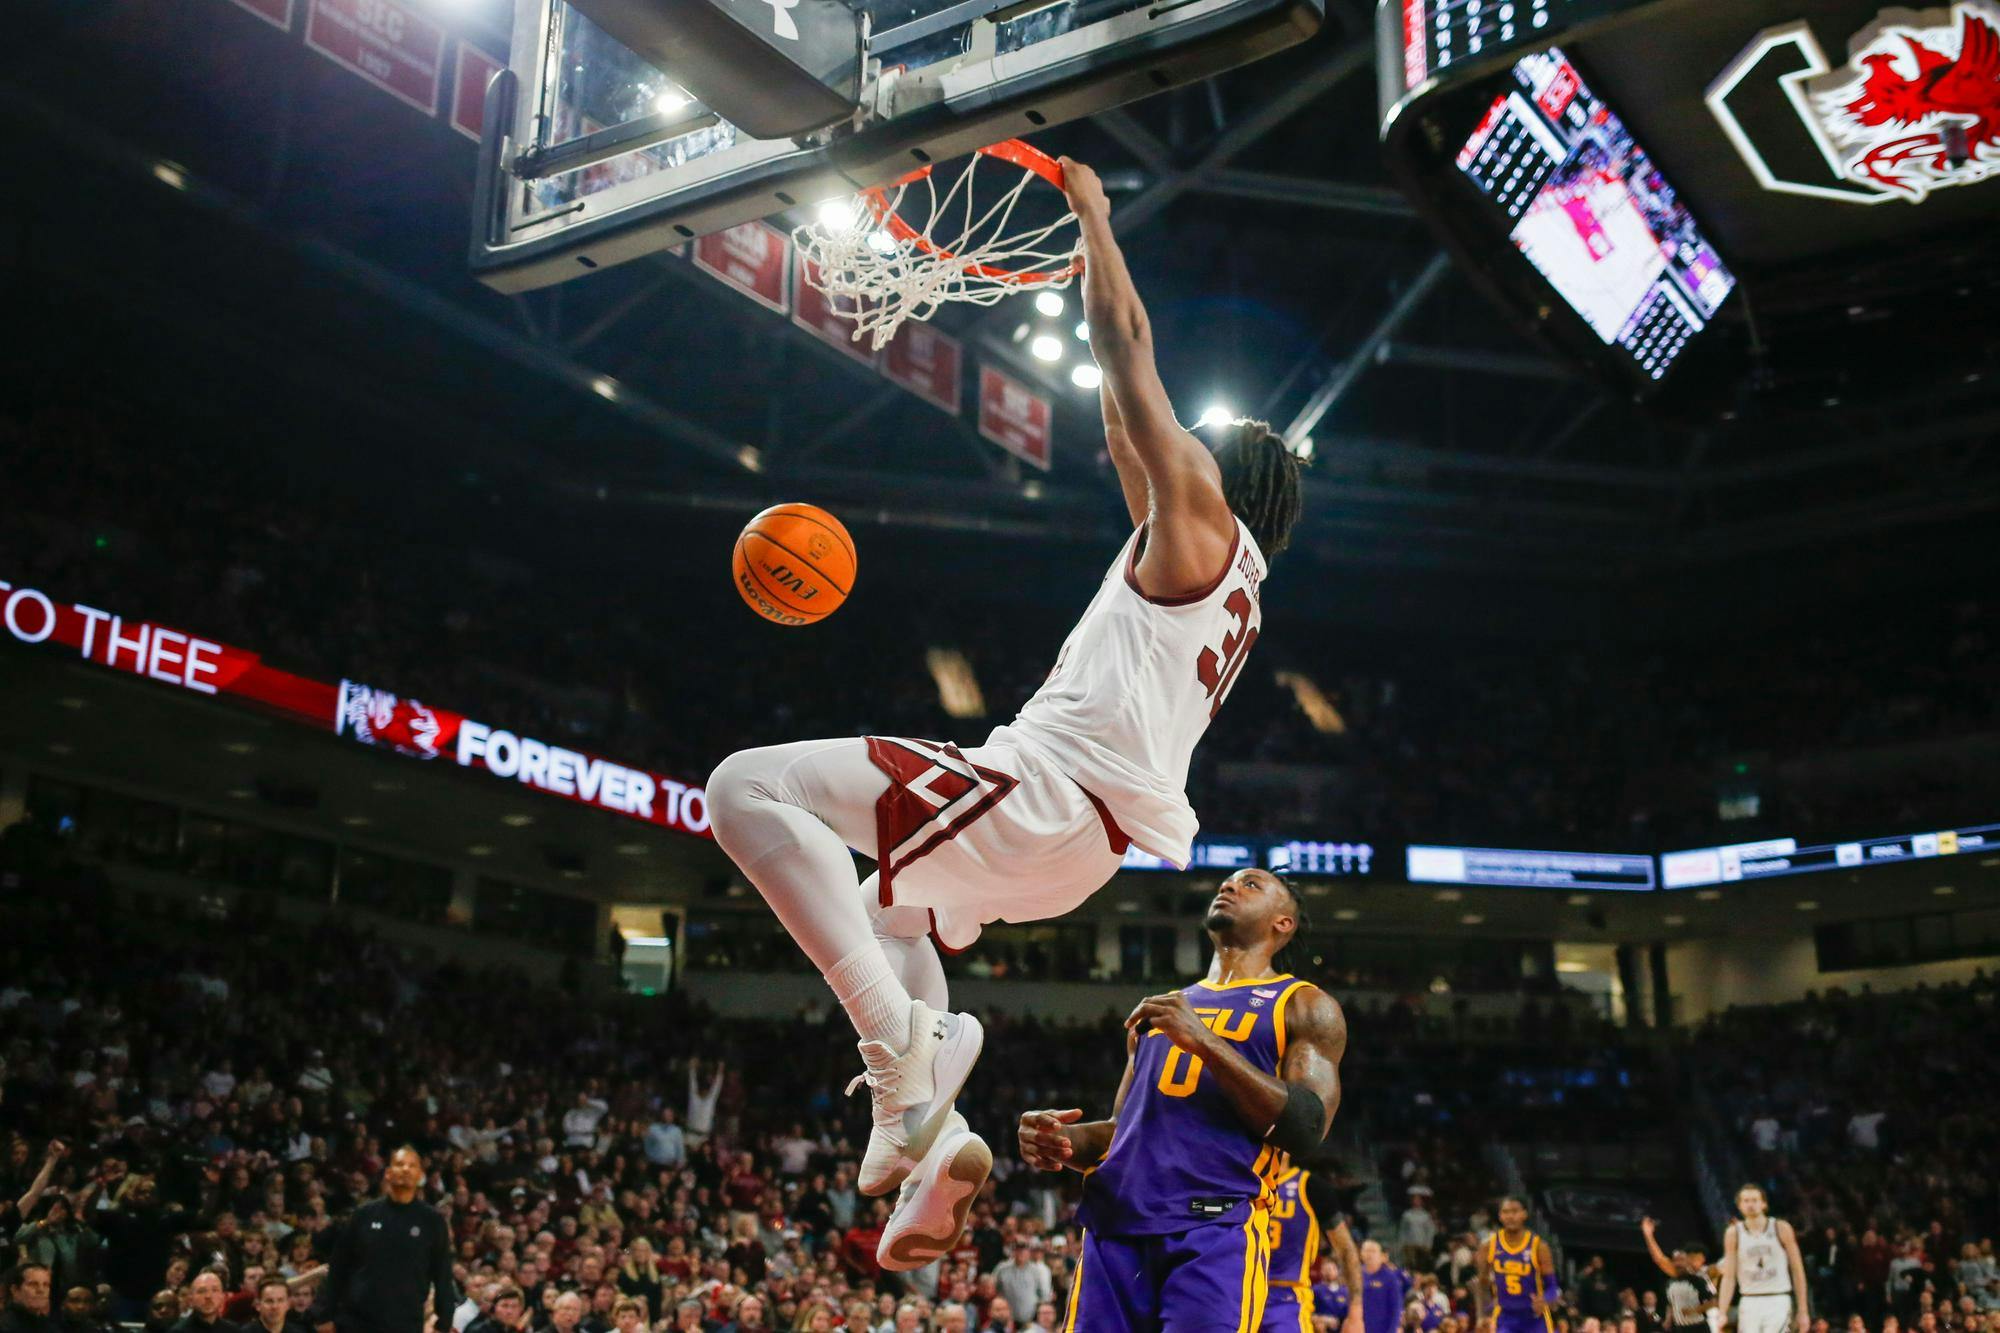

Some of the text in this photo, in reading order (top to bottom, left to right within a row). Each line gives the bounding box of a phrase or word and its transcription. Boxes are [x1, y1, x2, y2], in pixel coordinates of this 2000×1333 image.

[0, 580, 223, 695] O THEE
[456, 720, 709, 832] FOREVER TO
[1157, 1045, 1204, 1098] 0
[1494, 1260, 1531, 1277] LSU
[1504, 1274, 1523, 1295] 5
